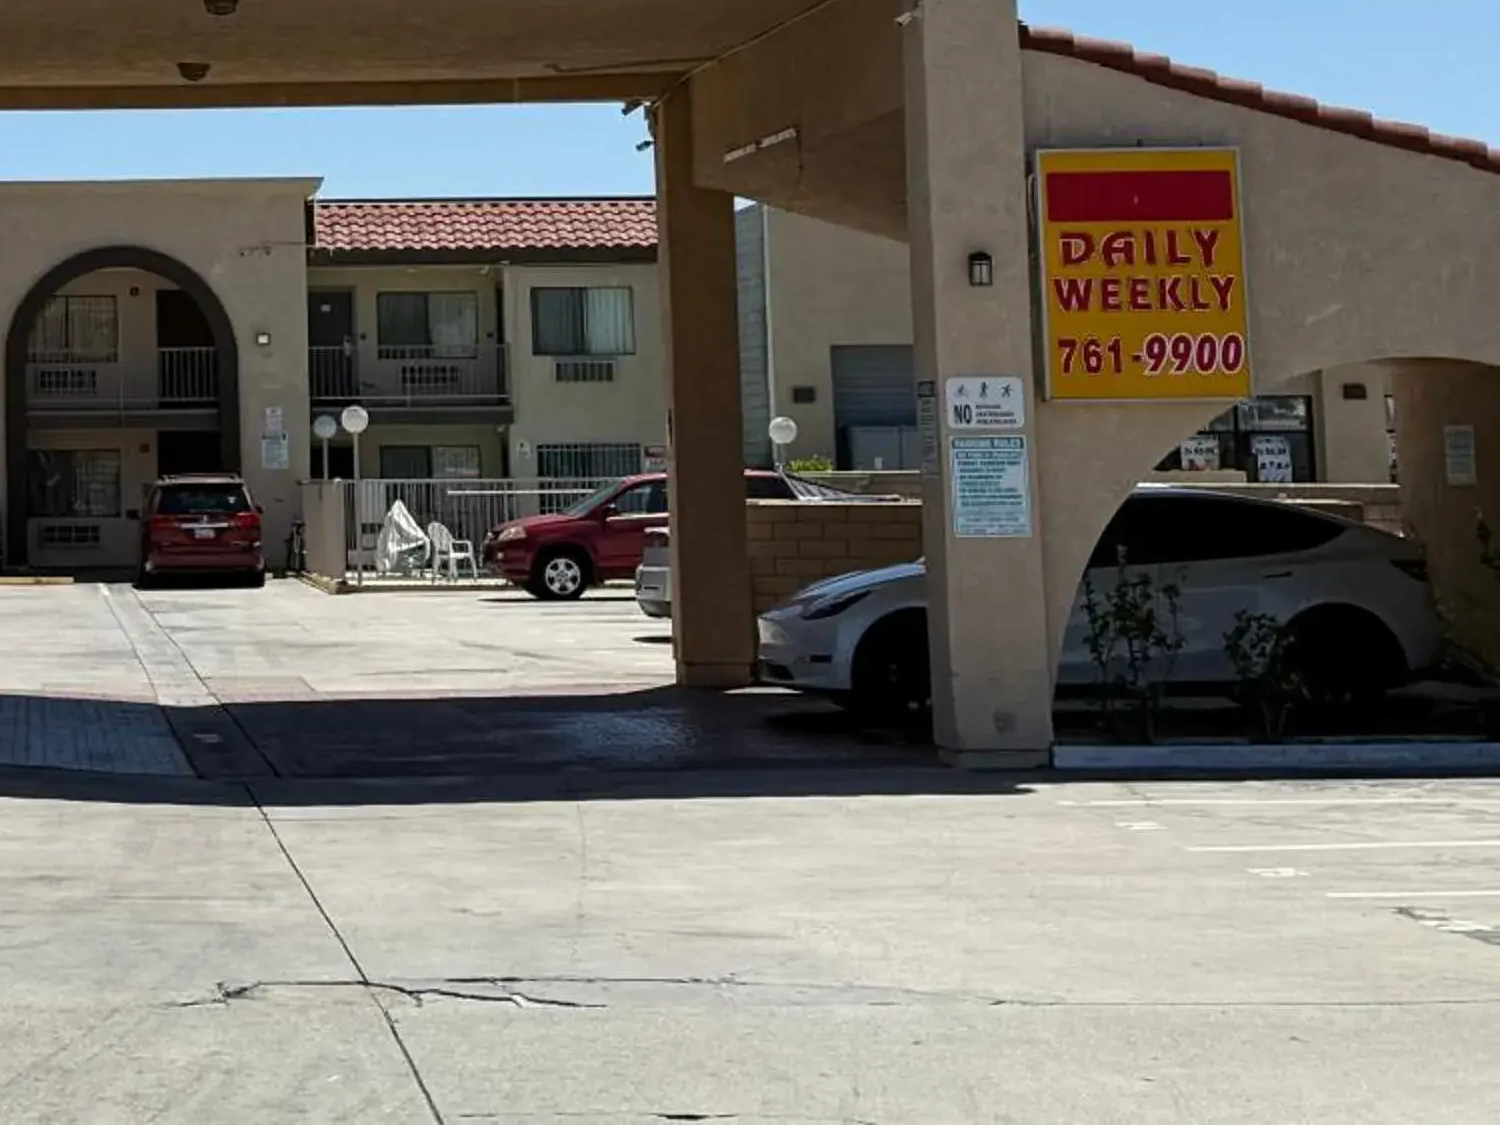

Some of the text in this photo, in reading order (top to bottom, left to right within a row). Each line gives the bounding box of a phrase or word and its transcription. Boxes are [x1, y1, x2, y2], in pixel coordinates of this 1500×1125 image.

[1059, 228, 1220, 268] DAILY
[1053, 274, 1236, 312] WEEKLY
[1057, 332, 1245, 376] 761-9900
[953, 404, 972, 424] NO
